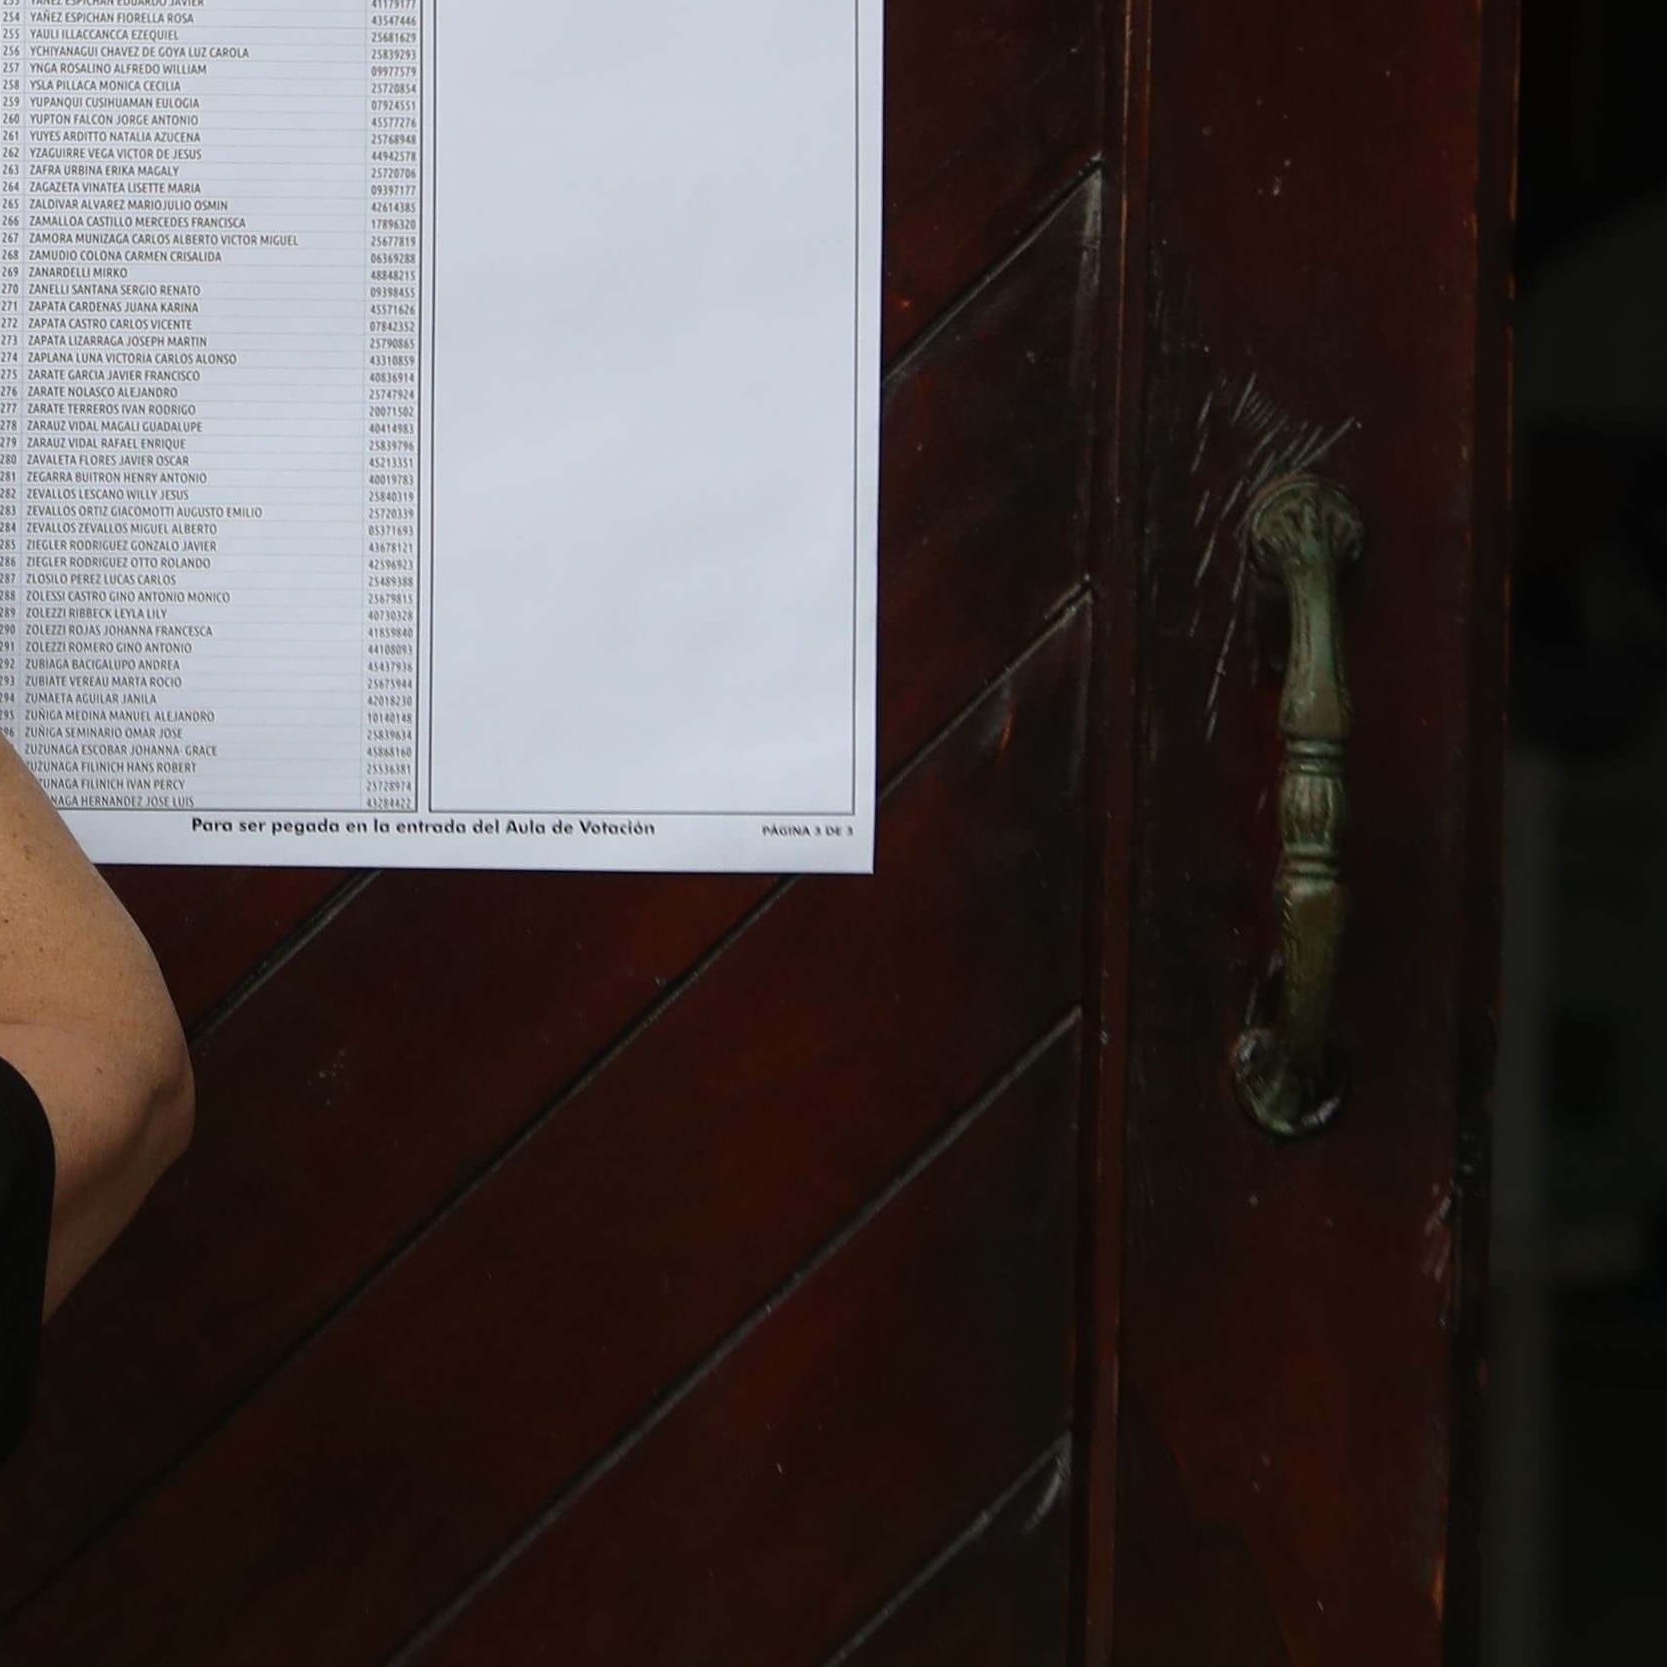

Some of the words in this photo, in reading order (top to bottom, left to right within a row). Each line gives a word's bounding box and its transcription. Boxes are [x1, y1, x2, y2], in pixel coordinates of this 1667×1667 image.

[192, 817, 232, 832] Para
[239, 821, 265, 832] ser
[271, 817, 339, 836] pegada
[345, 822, 367, 832] en
[374, 818, 389, 833] la
[396, 818, 465, 833] entrada
[472, 818, 499, 833] del
[505, 819, 545, 834] Aula
[552, 819, 573, 834] de
[579, 820, 654, 834] Votación
[762, 824, 810, 835] PÁGINA
[815, 826, 821, 835] 3
[825, 826, 841, 836] DE
[847, 826, 853, 835] 3
